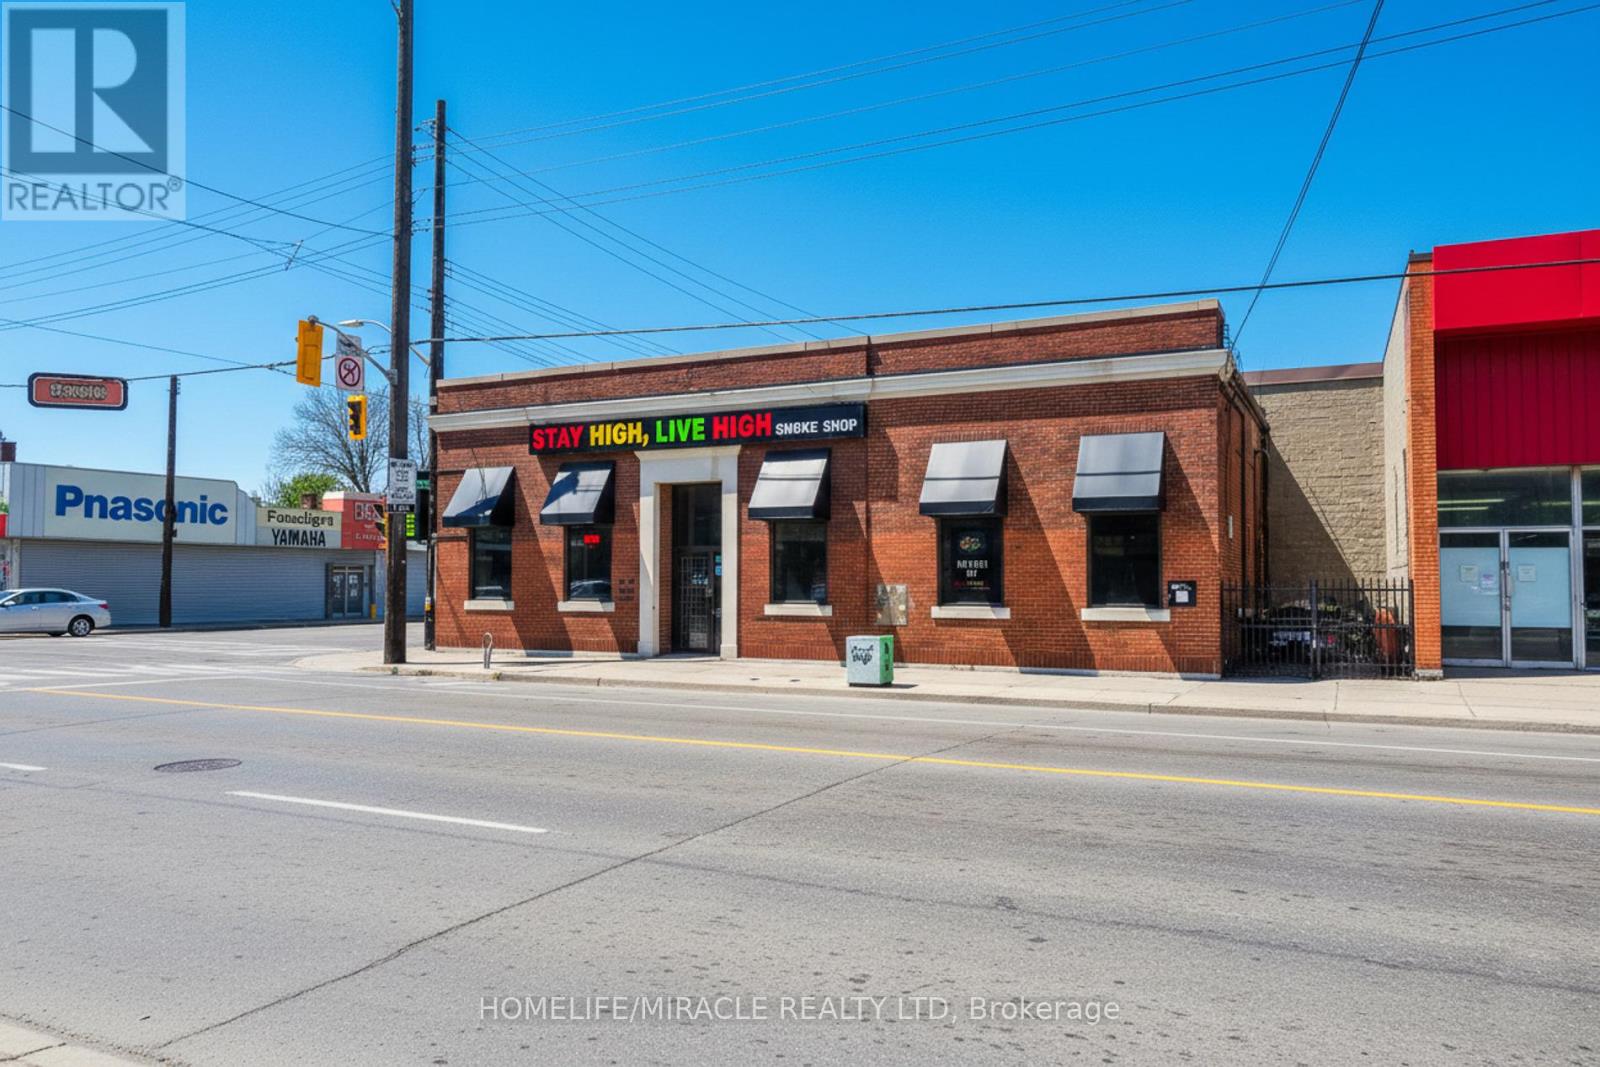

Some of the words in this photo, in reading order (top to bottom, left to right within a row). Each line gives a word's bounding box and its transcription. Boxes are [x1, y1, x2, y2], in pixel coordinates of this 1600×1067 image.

[532, 425, 584, 450] STAY
[589, 421, 650, 447] HIGH,
[656, 417, 705, 443] LIVE
[712, 412, 772, 439] HIGH
